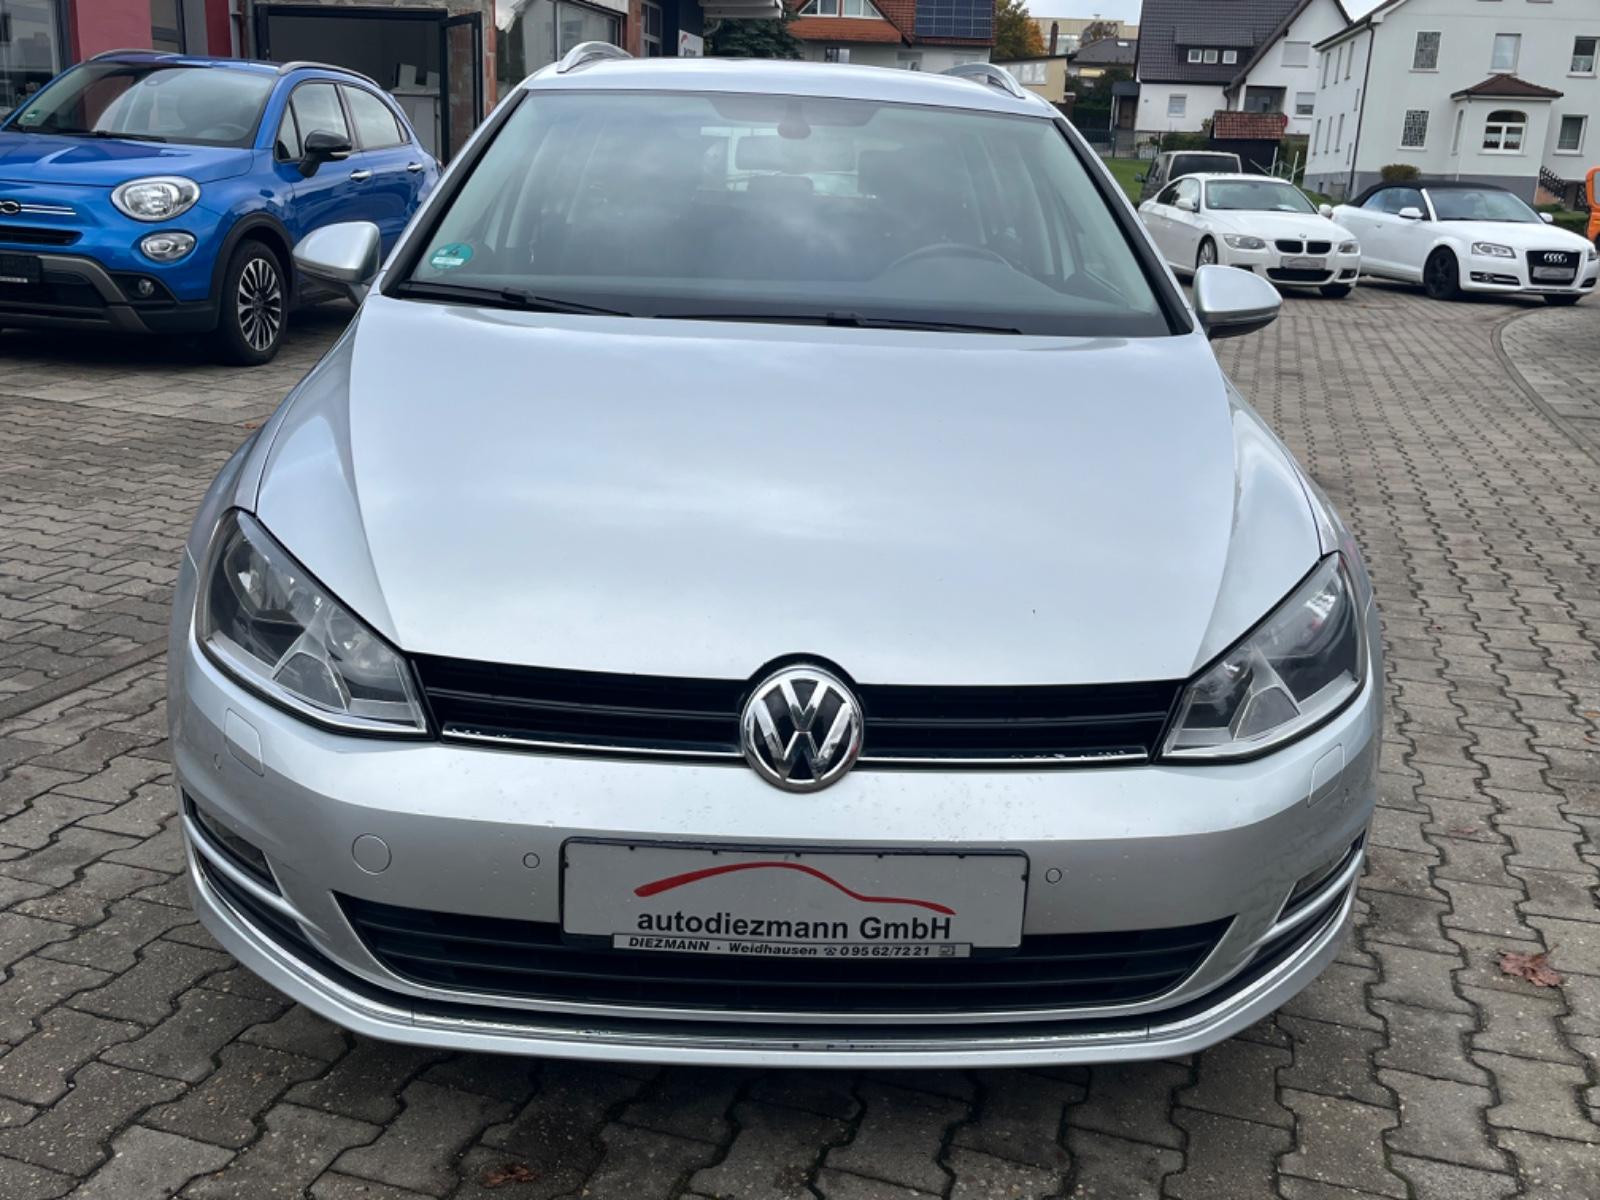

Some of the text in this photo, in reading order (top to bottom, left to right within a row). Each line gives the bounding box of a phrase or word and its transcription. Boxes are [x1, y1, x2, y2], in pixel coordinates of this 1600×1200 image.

[636, 911, 951, 940] autodiezmann GmbH
[629, 937, 711, 951] DIEZMANN
[728, 942, 817, 955] Weidhausen
